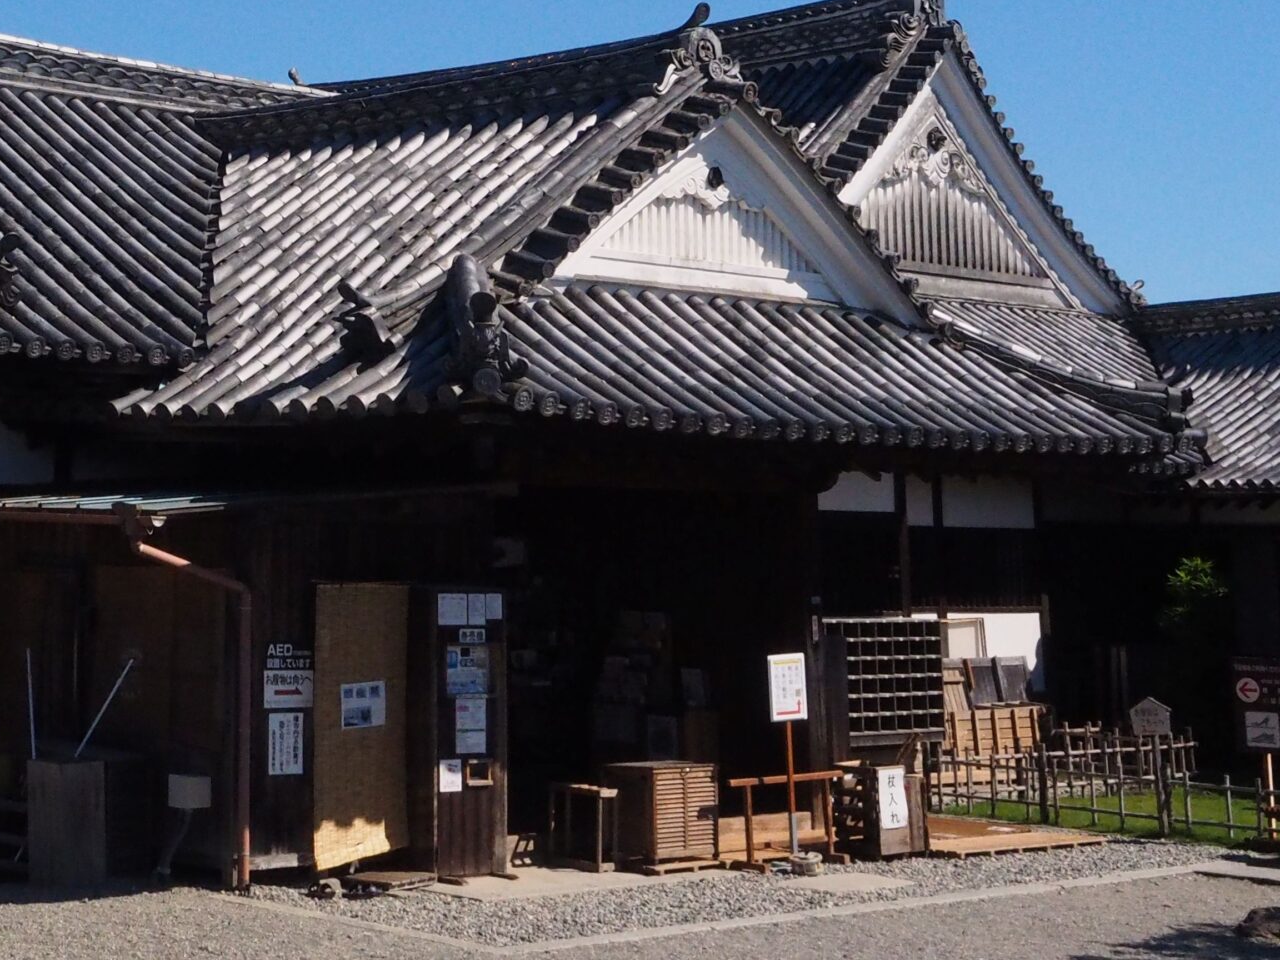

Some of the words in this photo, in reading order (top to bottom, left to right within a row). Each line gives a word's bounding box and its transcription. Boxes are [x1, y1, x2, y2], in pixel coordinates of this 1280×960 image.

[267, 644, 293, 656] AED
[267, 658, 311, 668] 設置しています
[887, 774, 901, 824] 杖入れ
